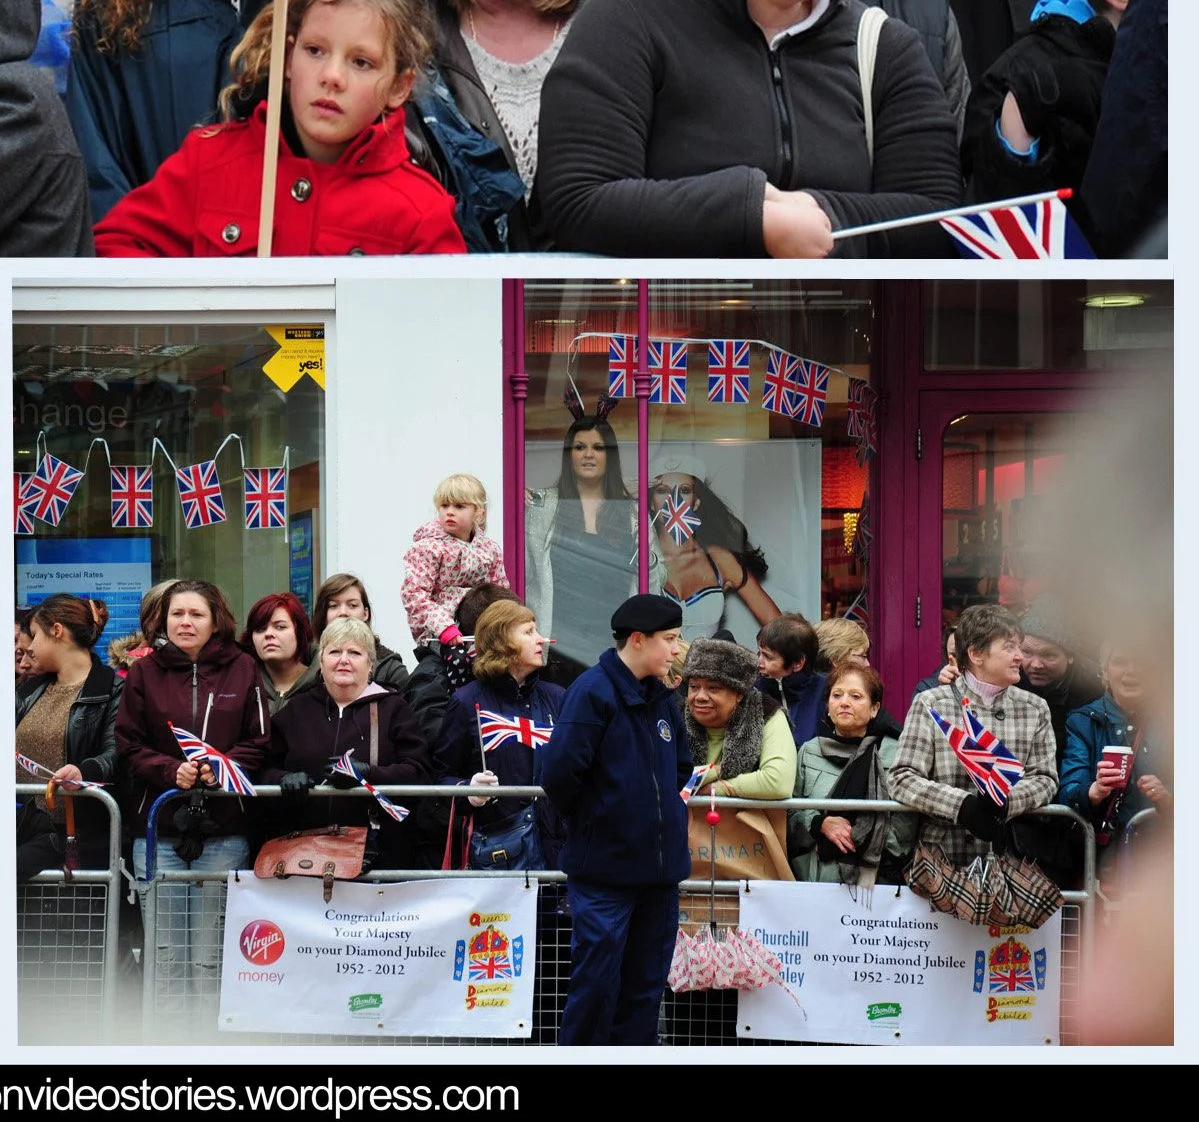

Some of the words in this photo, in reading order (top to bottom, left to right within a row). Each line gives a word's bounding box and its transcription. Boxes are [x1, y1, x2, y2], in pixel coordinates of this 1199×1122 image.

[298, 357, 323, 373] yes!
[25, 571, 54, 580] Today's
[55, 571, 82, 580] Special
[84, 570, 104, 578] Rates
[1120, 754, 1128, 780] COSTA
[324, 909, 420, 925] Congratulations
[469, 913, 508, 927] Queen's
[840, 914, 939, 930] Congratulations
[243, 924, 282, 960] Virgin
[333, 927, 362, 939] Your
[366, 928, 412, 943] Majesty
[754, 928, 809, 948] Churchill
[851, 934, 882, 947] Your
[884, 935, 931, 951] Majesty
[297, 946, 312, 955] on
[314, 947, 342, 959] your
[346, 945, 402, 958] Diamond
[403, 946, 447, 960] Jubilee
[336, 962, 364, 975] 1952
[375, 963, 405, 976] 2012
[813, 953, 829, 962] on
[832, 954, 860, 968] your
[863, 953, 922, 967] Diamond
[922, 956, 966, 970] Jubilee
[238, 970, 285, 985] money
[853, 970, 883, 983] 1952
[894, 971, 925, 985] 2012
